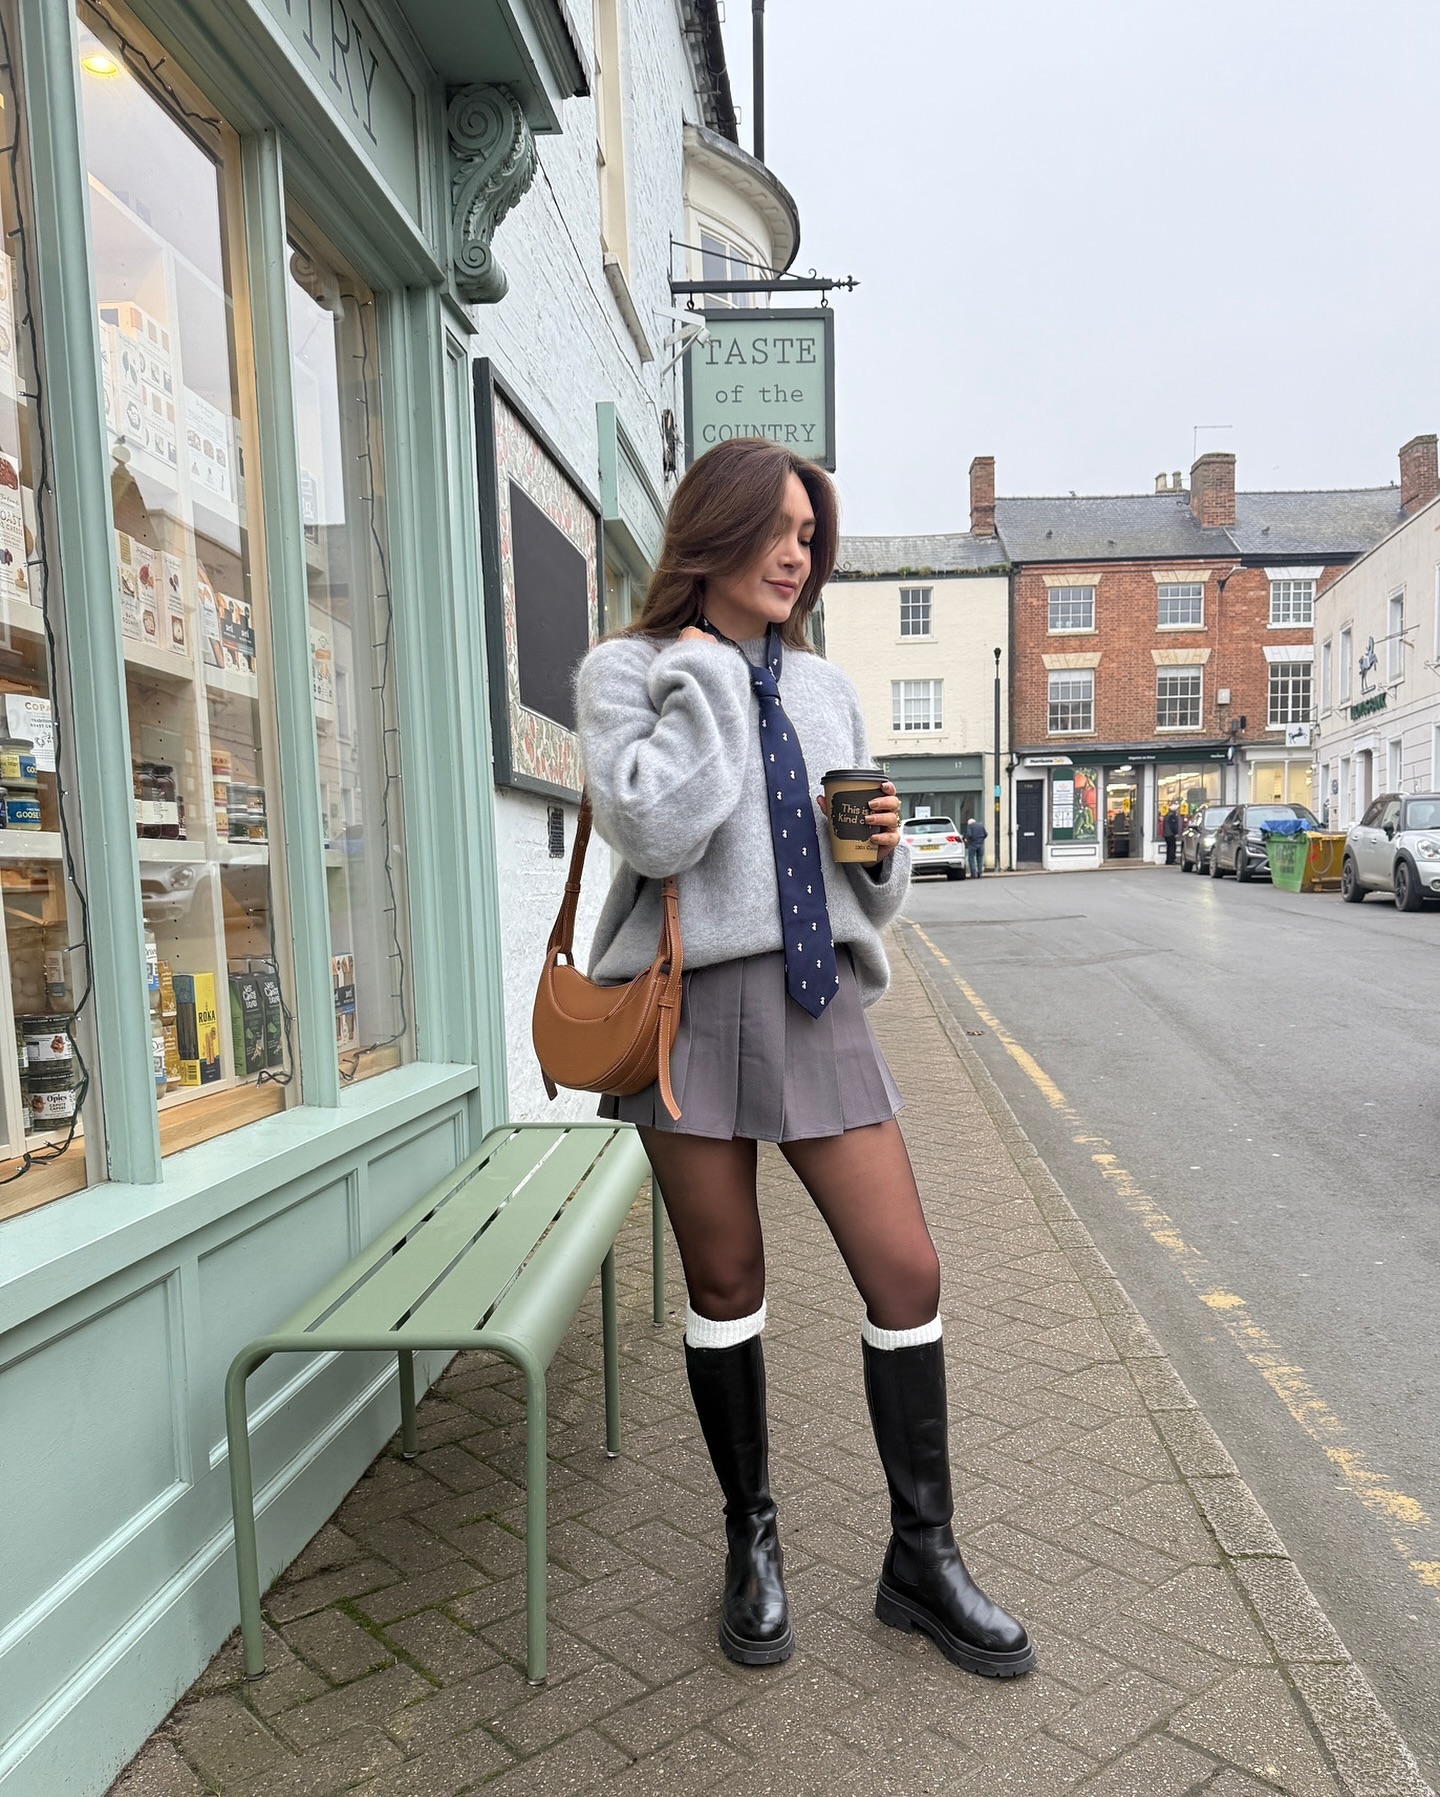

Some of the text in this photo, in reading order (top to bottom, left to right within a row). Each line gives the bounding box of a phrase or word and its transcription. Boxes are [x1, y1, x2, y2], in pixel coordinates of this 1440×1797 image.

[697, 337, 816, 365] TASTE
[716, 384, 804, 403] of the
[702, 424, 816, 443] COUNTRY
[842, 803, 869, 816] This is
[838, 812, 858, 824] Kind
[198, 1010, 216, 1023] ROKA
